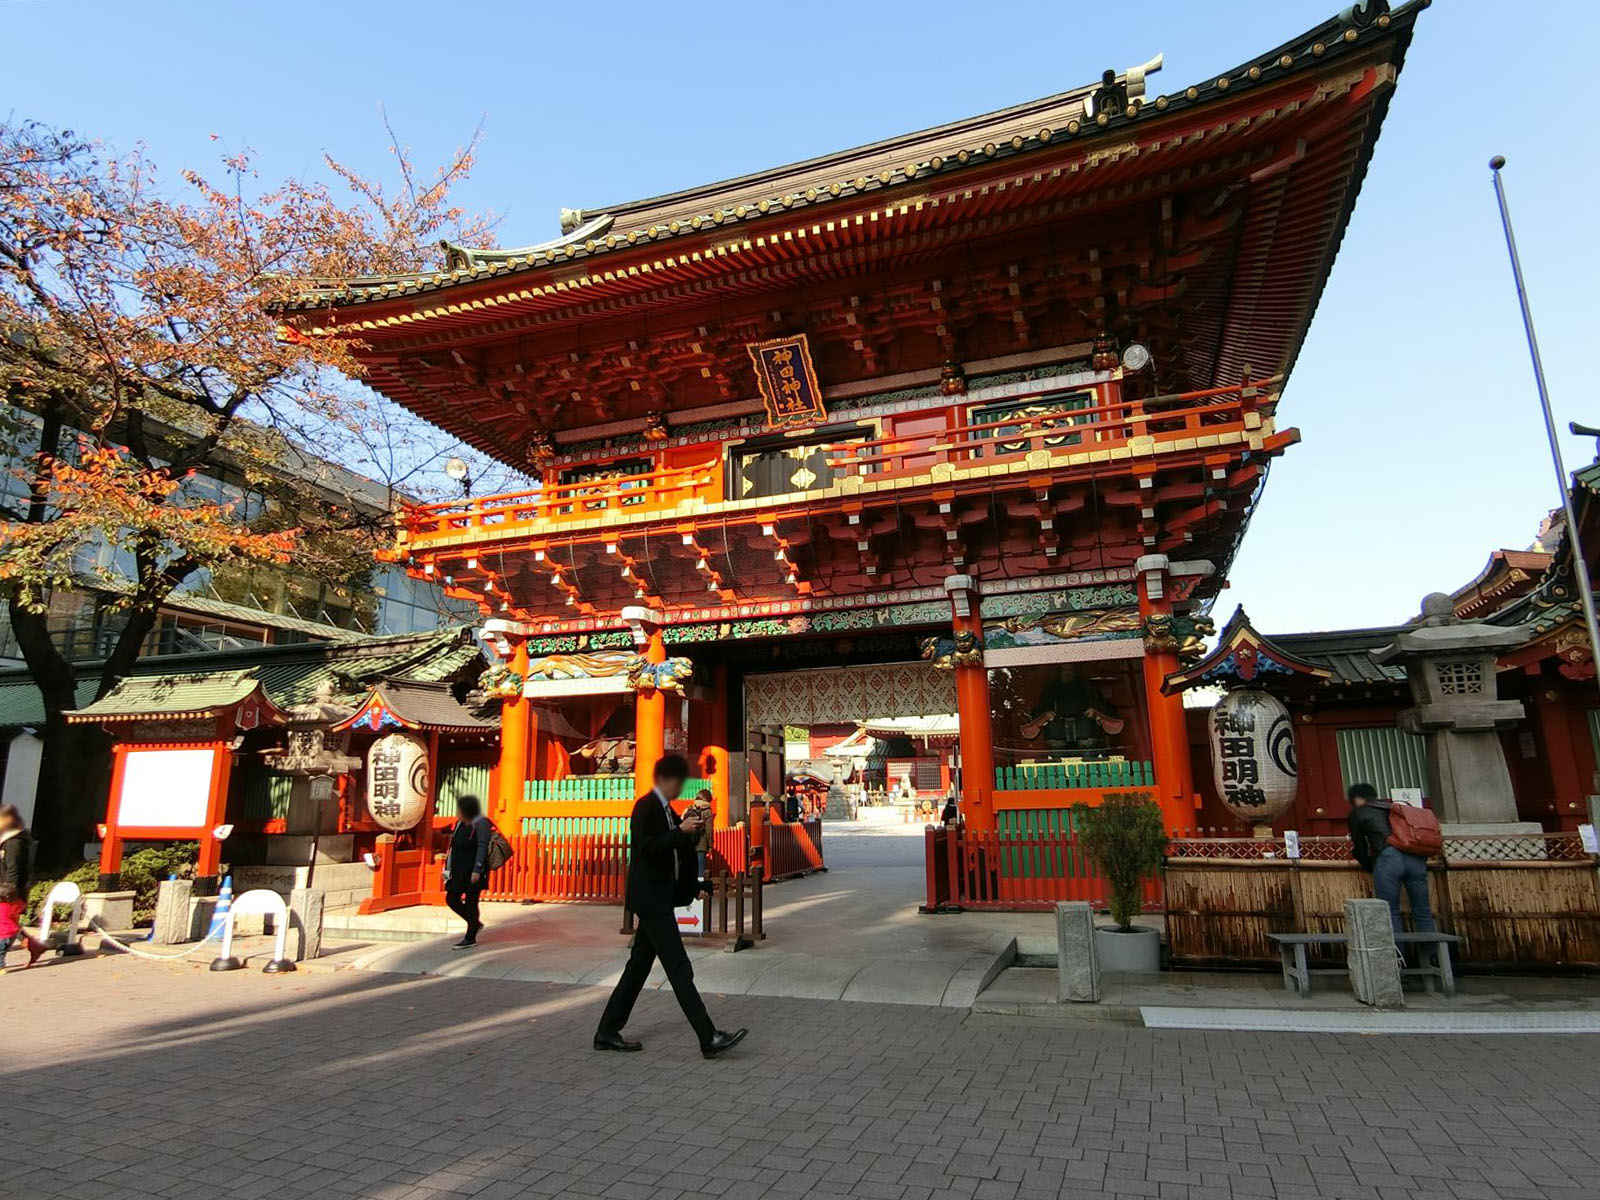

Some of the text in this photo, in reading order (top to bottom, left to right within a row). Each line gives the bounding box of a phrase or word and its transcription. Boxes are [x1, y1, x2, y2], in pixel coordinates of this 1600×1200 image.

[773, 348, 807, 411] 神田神社
[372, 742, 401, 818] 神田明神
[1214, 705, 1266, 807] 神田明神
